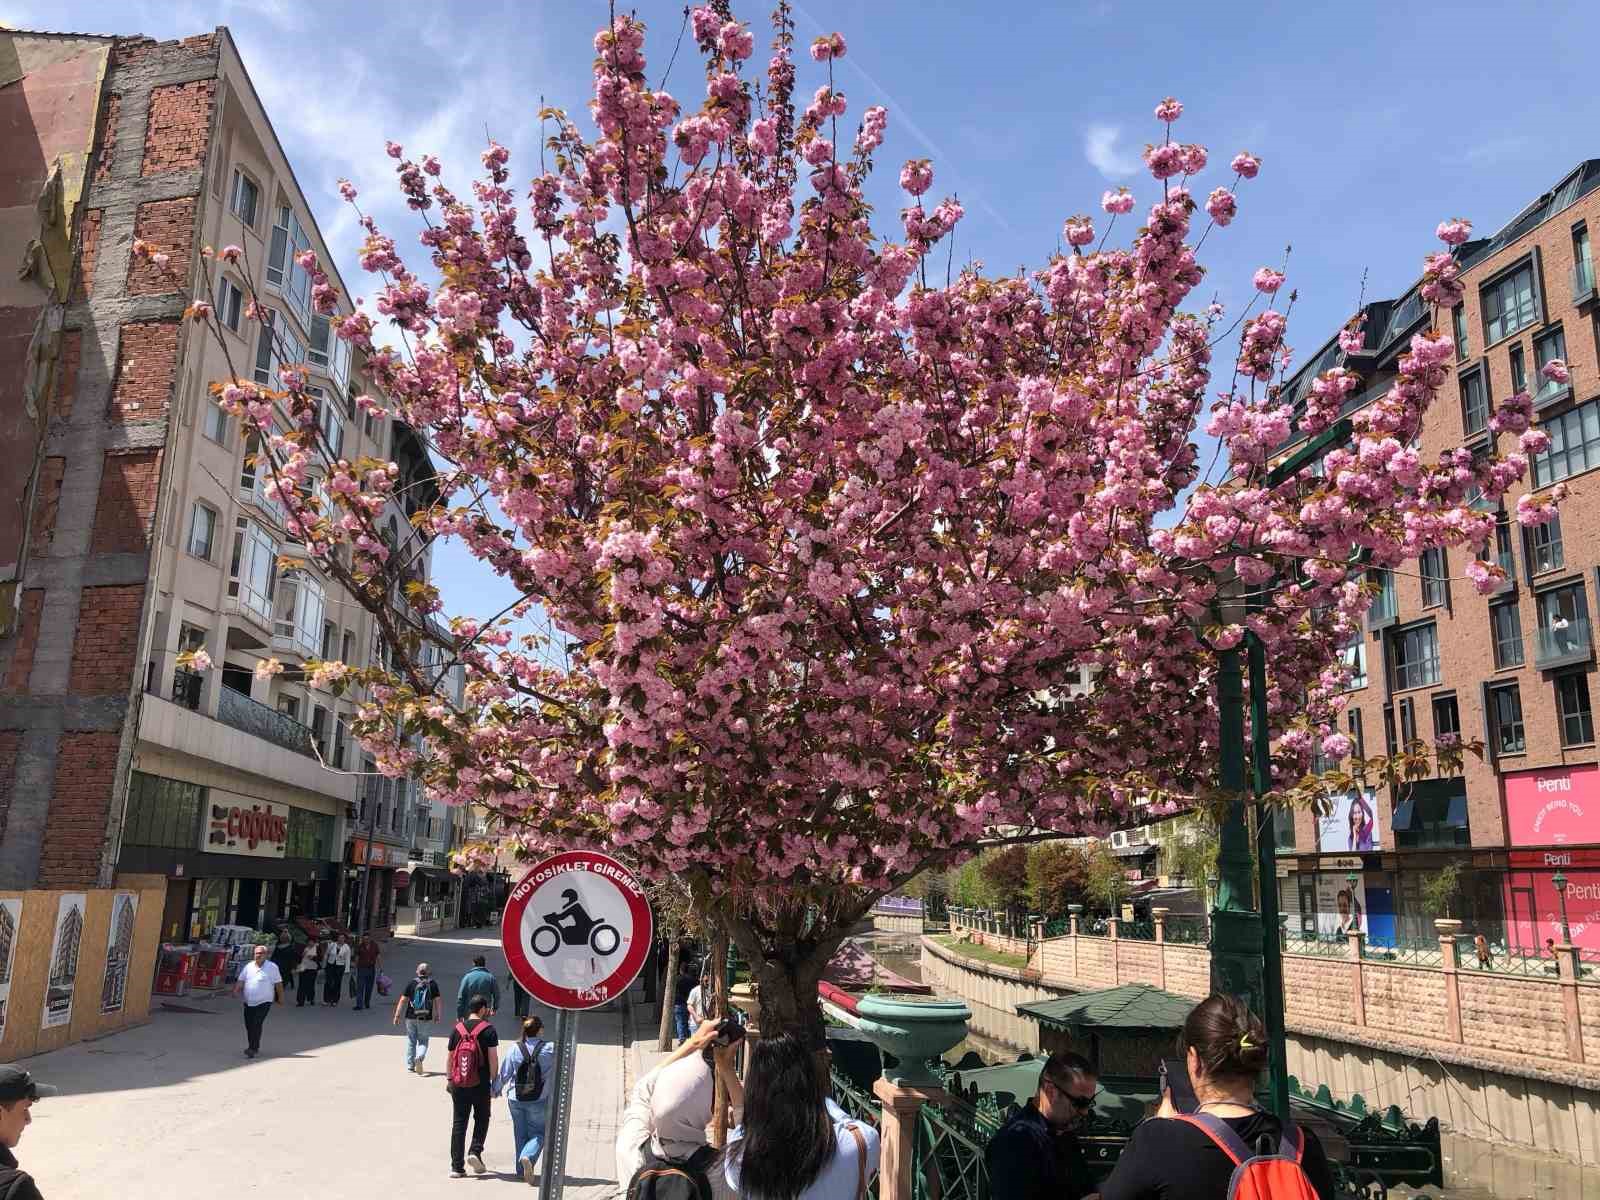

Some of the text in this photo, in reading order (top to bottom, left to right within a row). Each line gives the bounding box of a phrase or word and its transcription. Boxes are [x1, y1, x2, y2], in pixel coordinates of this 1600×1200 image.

[1537, 776, 1571, 792] Penti
[1544, 853, 1571, 865] Penti
[512, 861, 644, 901] MOTOSİKLET GİREMEZ
